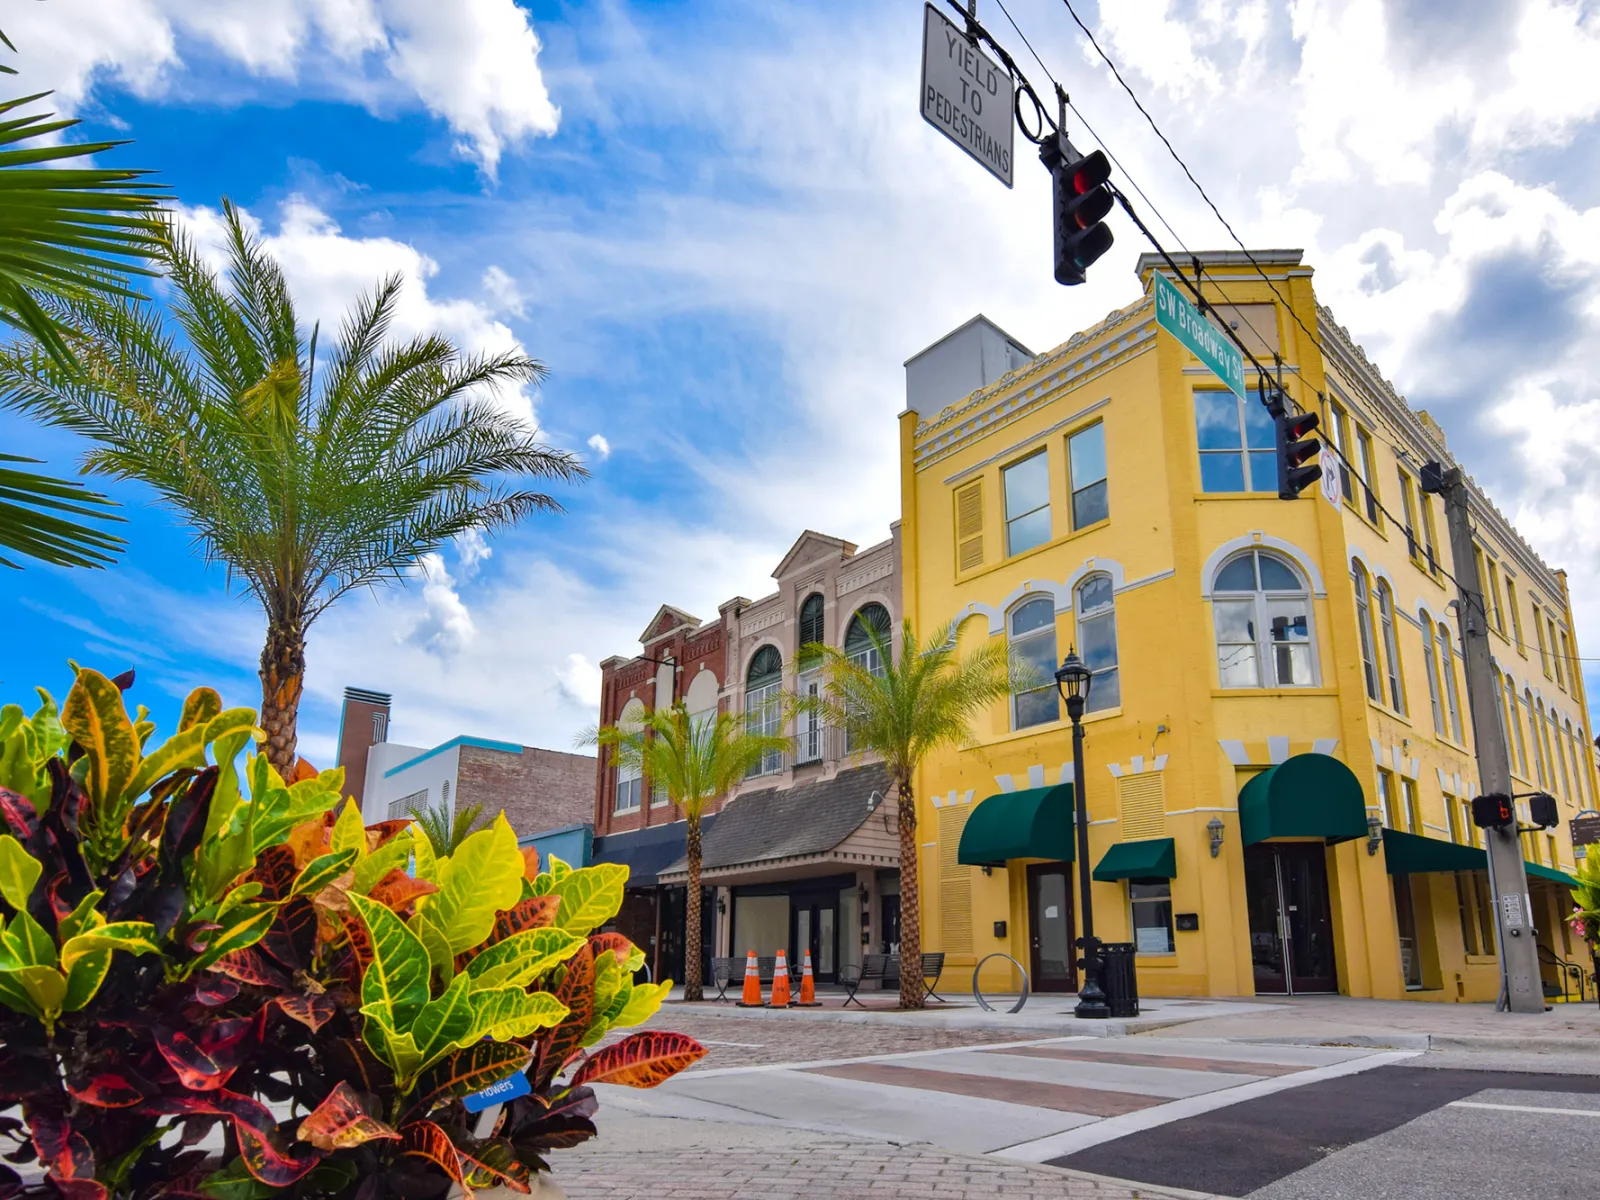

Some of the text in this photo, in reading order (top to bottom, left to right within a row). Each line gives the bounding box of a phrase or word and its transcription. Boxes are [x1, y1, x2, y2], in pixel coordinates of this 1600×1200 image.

[945, 30, 997, 97] YIELD
[959, 76, 983, 116] TO
[926, 84, 1009, 174] PEDESTRIANS
[1158, 283, 1243, 385] SW Broadway St
